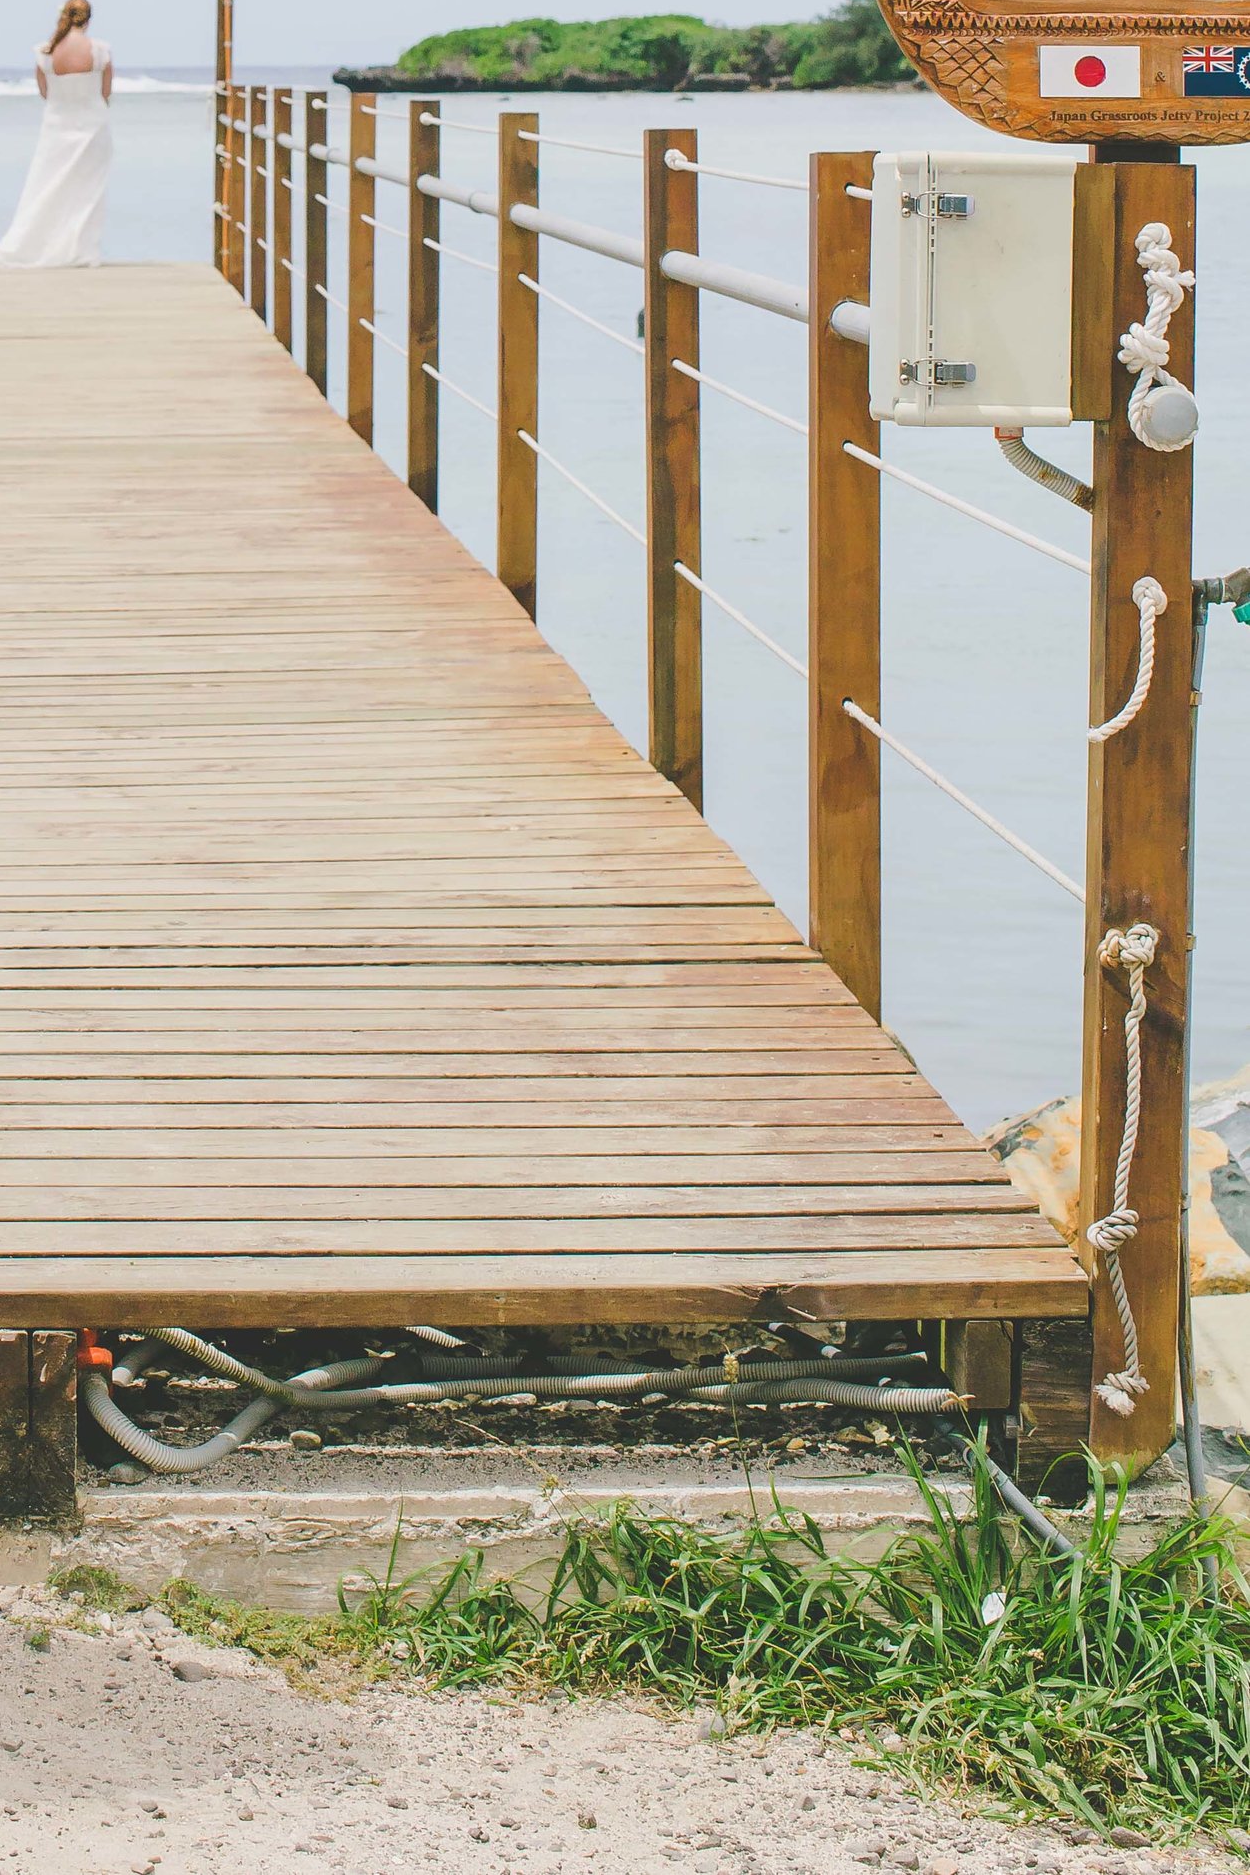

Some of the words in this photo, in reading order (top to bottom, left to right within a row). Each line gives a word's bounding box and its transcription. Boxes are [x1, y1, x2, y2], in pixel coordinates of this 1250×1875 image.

[1155, 70, 1166, 82] &
[1049, 110, 1087, 123] Japan
[1090, 110, 1157, 122] Grassroots
[1160, 110, 1191, 123] Jetty
[1195, 109, 1239, 124] Project
